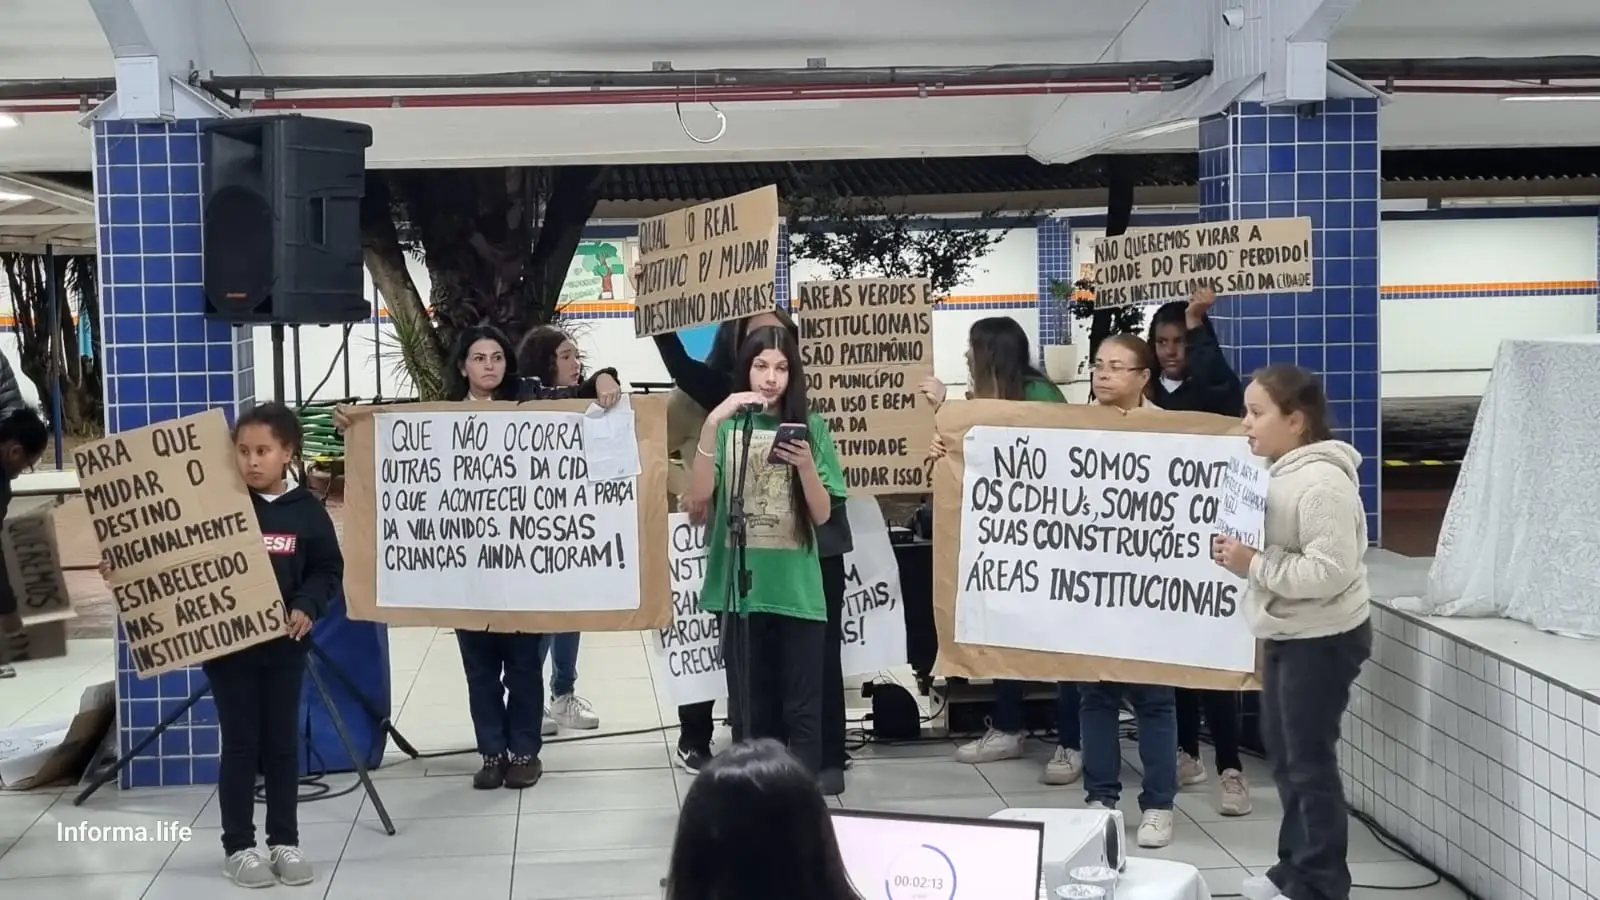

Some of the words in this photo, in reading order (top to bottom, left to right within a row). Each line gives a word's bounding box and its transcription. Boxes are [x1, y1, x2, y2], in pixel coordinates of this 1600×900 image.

[640, 220, 670, 255] QUAL
[704, 203, 738, 240] REAL
[1094, 238, 1119, 264] NÃO
[1124, 229, 1191, 259] QUEREMOS
[1196, 225, 1240, 247] VIRAR
[1248, 225, 1262, 241] A
[699, 250, 713, 283] P/
[719, 239, 769, 279] MUDAR
[1095, 262, 1142, 285] CIDADE
[1151, 257, 1173, 278] DO
[1180, 249, 1228, 274] FUNDO
[1240, 240, 1310, 268] PERDIDO!
[799, 282, 853, 311] ÁREAS
[858, 283, 916, 307] VERDES
[923, 284, 932, 304] E
[1095, 283, 1128, 308] ÁREAS
[1227, 270, 1254, 293] SÃO
[1258, 273, 1275, 289] DA
[1276, 272, 1311, 289] CIDADE
[634, 306, 642, 335] O
[711, 289, 731, 320] DAS
[800, 312, 930, 339] INSTITUCIONAIS
[801, 342, 834, 366] SÃO
[840, 338, 923, 365] PATRIMÔNIO
[829, 368, 905, 390] MUNICÍPIO
[841, 395, 867, 413] USO
[871, 394, 879, 409] E
[882, 393, 915, 410] BEM
[392, 419, 432, 452] QUE
[452, 414, 488, 451] NÃO
[504, 422, 583, 452] OCORRA
[849, 416, 868, 433] DA
[75, 439, 132, 479] PARA
[152, 423, 201, 458] QUE
[382, 457, 441, 484] OUTRAS
[454, 453, 517, 483] PRAÇAS
[530, 456, 550, 480] DA
[558, 455, 588, 480] CID
[993, 434, 1047, 480] NÃO
[1069, 446, 1151, 483] SOMOS
[1168, 457, 1228, 488] CONT
[84, 470, 164, 515] MUDAR
[186, 459, 204, 486] O
[893, 457, 934, 488] ISSO?
[382, 491, 390, 511] O
[396, 489, 427, 511] QUE
[438, 485, 526, 512] ACONTECEU
[534, 485, 566, 510] COM
[574, 485, 587, 506] A
[595, 481, 633, 506] PRAÇA
[971, 476, 1003, 514] OS
[1101, 487, 1179, 522] SOMOS
[93, 498, 181, 542] DESTINO
[383, 518, 399, 540] DA
[407, 518, 436, 540] VILA
[439, 516, 501, 540] UNIDOS.
[509, 513, 596, 541] NOSSAS
[978, 516, 1028, 546] SUAS
[1033, 519, 1200, 563] CONSTRUÇÕES
[101, 512, 248, 570] ORIGINALMENTE
[263, 536, 292, 552] ESI
[385, 545, 467, 572] CRIANÇAS
[477, 543, 526, 569] AINDA
[113, 551, 249, 613] ESTABELECIDO
[965, 551, 1039, 593] ÁREAS
[1049, 567, 1238, 618] INSTITUCIONAIS
[125, 612, 164, 643] NAS
[175, 586, 236, 627] ÁREAS
[132, 600, 289, 672] INSTITUCIONAIS?
[894, 874, 944, 890] 00:02:13
